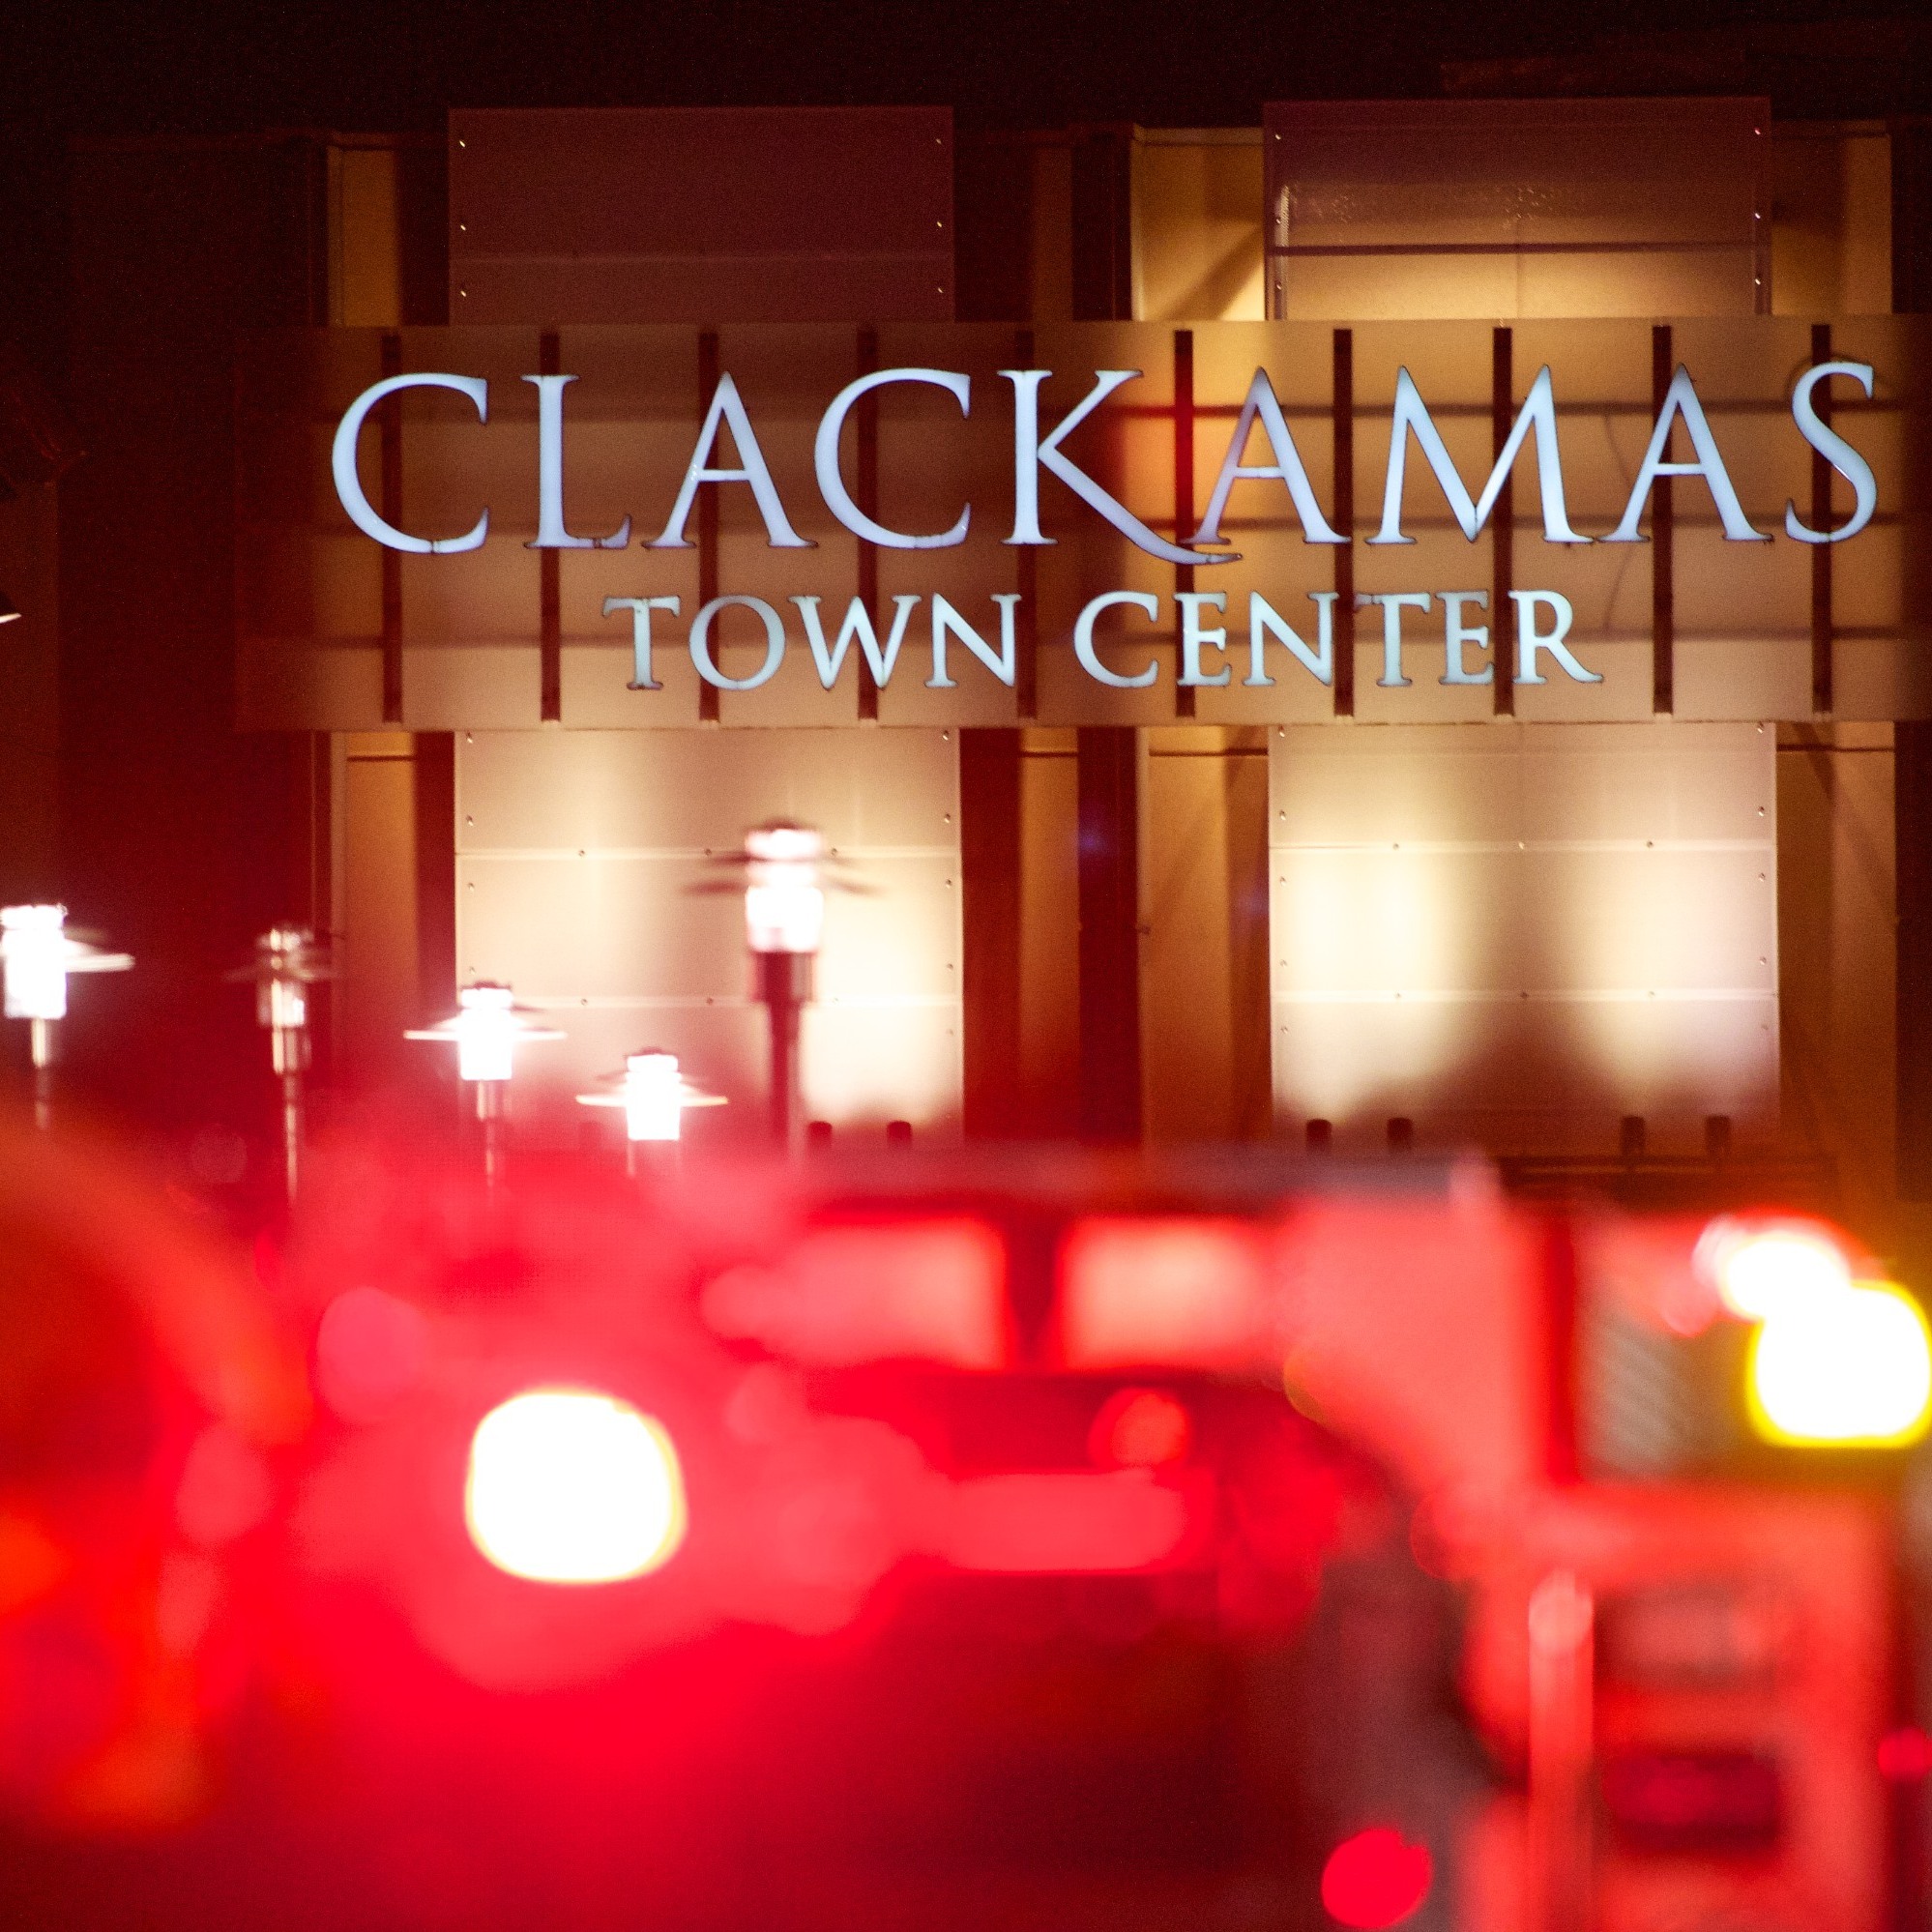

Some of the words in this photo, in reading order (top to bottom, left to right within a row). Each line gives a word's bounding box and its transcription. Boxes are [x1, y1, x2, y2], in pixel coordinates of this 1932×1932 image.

[331, 360, 1879, 566] CLACKAMAS
[601, 592, 1022, 692] TOWN
[1072, 588, 1606, 688] CENTER
